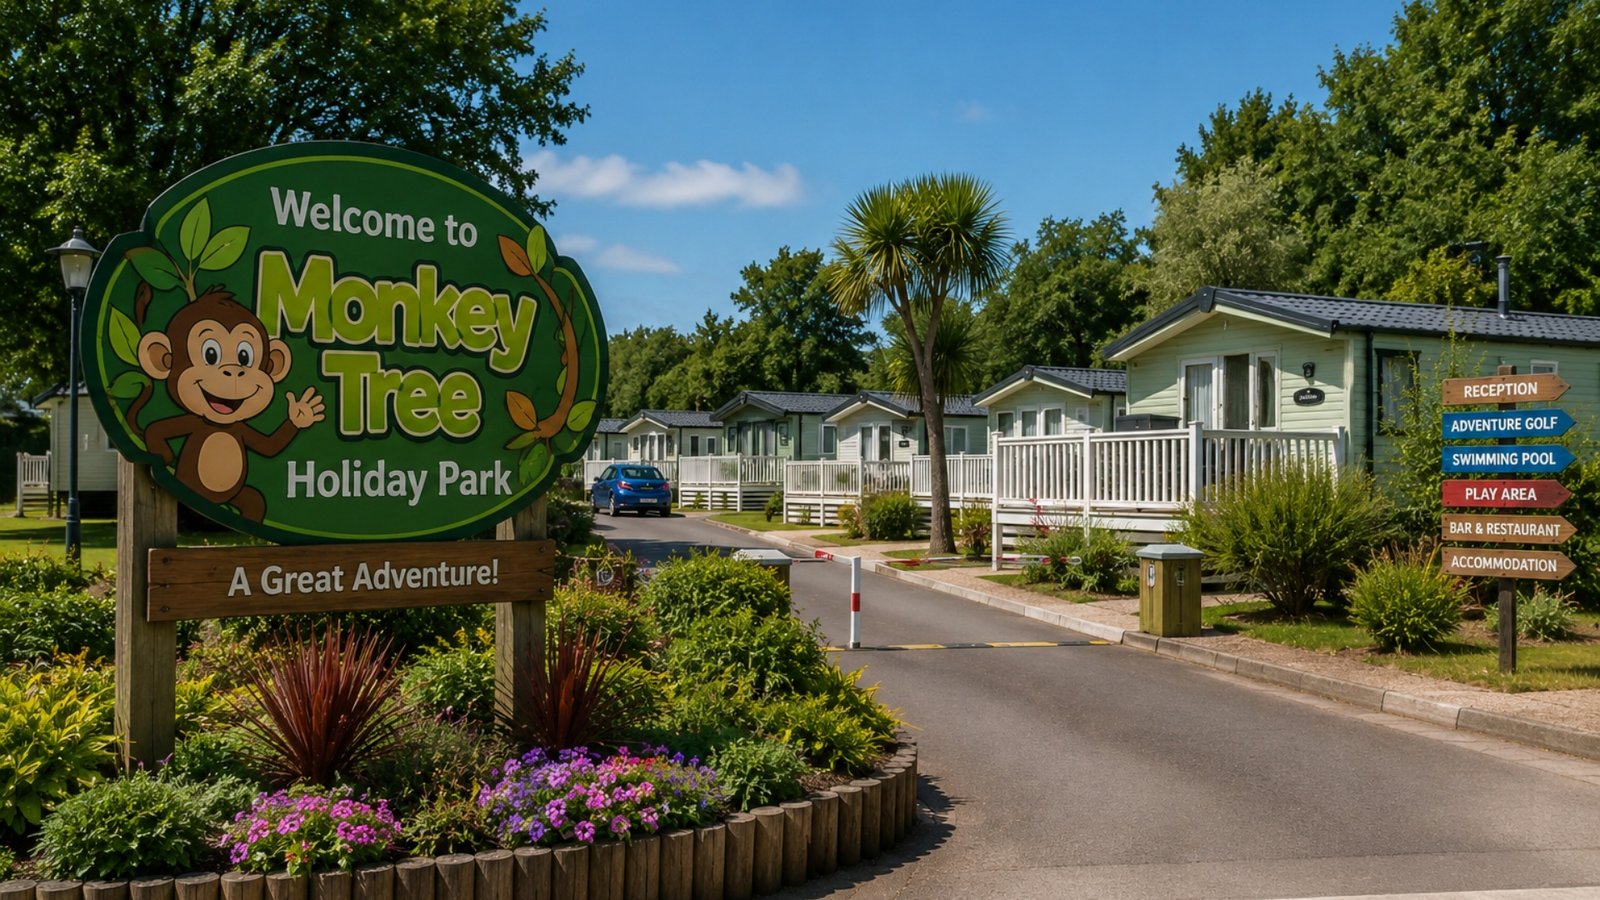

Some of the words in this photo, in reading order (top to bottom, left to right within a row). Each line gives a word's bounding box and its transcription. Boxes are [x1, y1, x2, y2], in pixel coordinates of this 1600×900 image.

[270, 186, 435, 243] Welcome
[445, 214, 478, 248] to
[257, 250, 538, 373] Monkey
[322, 350, 482, 437] Tree
[1464, 382, 1538, 398] RECEPTION
[1451, 418, 1522, 432] ADVENTURE
[1525, 416, 1559, 430] GOLF
[1452, 453, 1518, 466] SWIMMING
[1522, 452, 1556, 465] POOL
[286, 460, 428, 506] Holiday
[438, 460, 512, 496] Park
[1465, 488, 1498, 501] PLAY
[1501, 488, 1537, 501] AREA
[1449, 522, 1473, 534] BAR
[1475, 523, 1484, 535] &
[1486, 523, 1561, 537] RESTAURANT
[1451, 555, 1557, 572] ACCOMMODATION
[228, 566, 251, 597] A
[260, 565, 344, 595] Great
[352, 559, 499, 592] Adventure!
